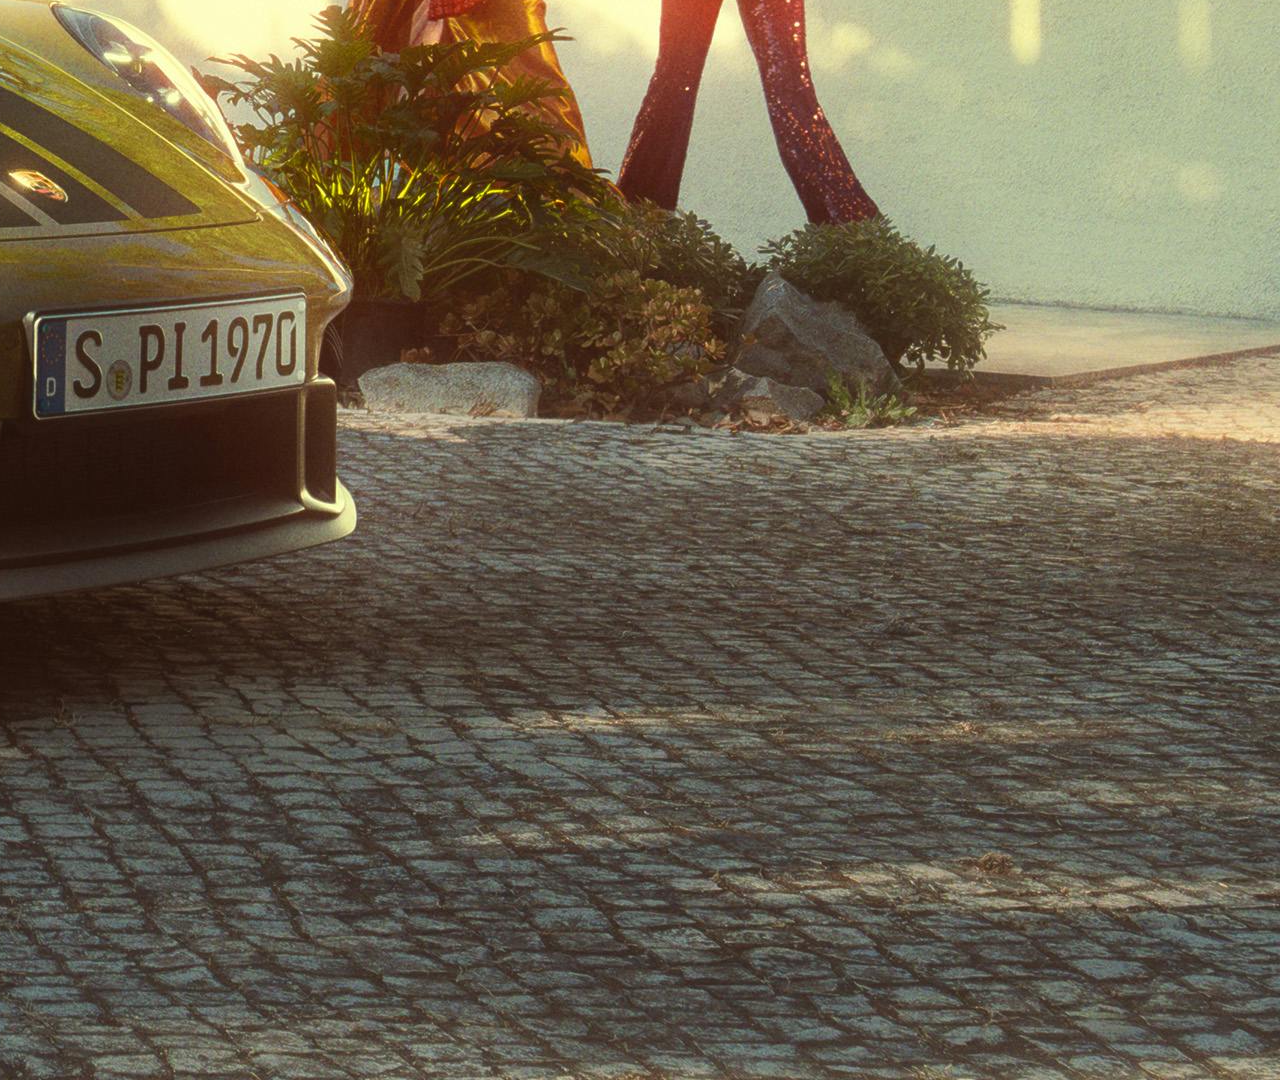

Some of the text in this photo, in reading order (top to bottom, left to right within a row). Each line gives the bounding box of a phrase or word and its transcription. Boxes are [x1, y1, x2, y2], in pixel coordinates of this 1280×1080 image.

[73, 329, 103, 399] S
[200, 310, 297, 387] 1970
[46, 377, 56, 397] D
